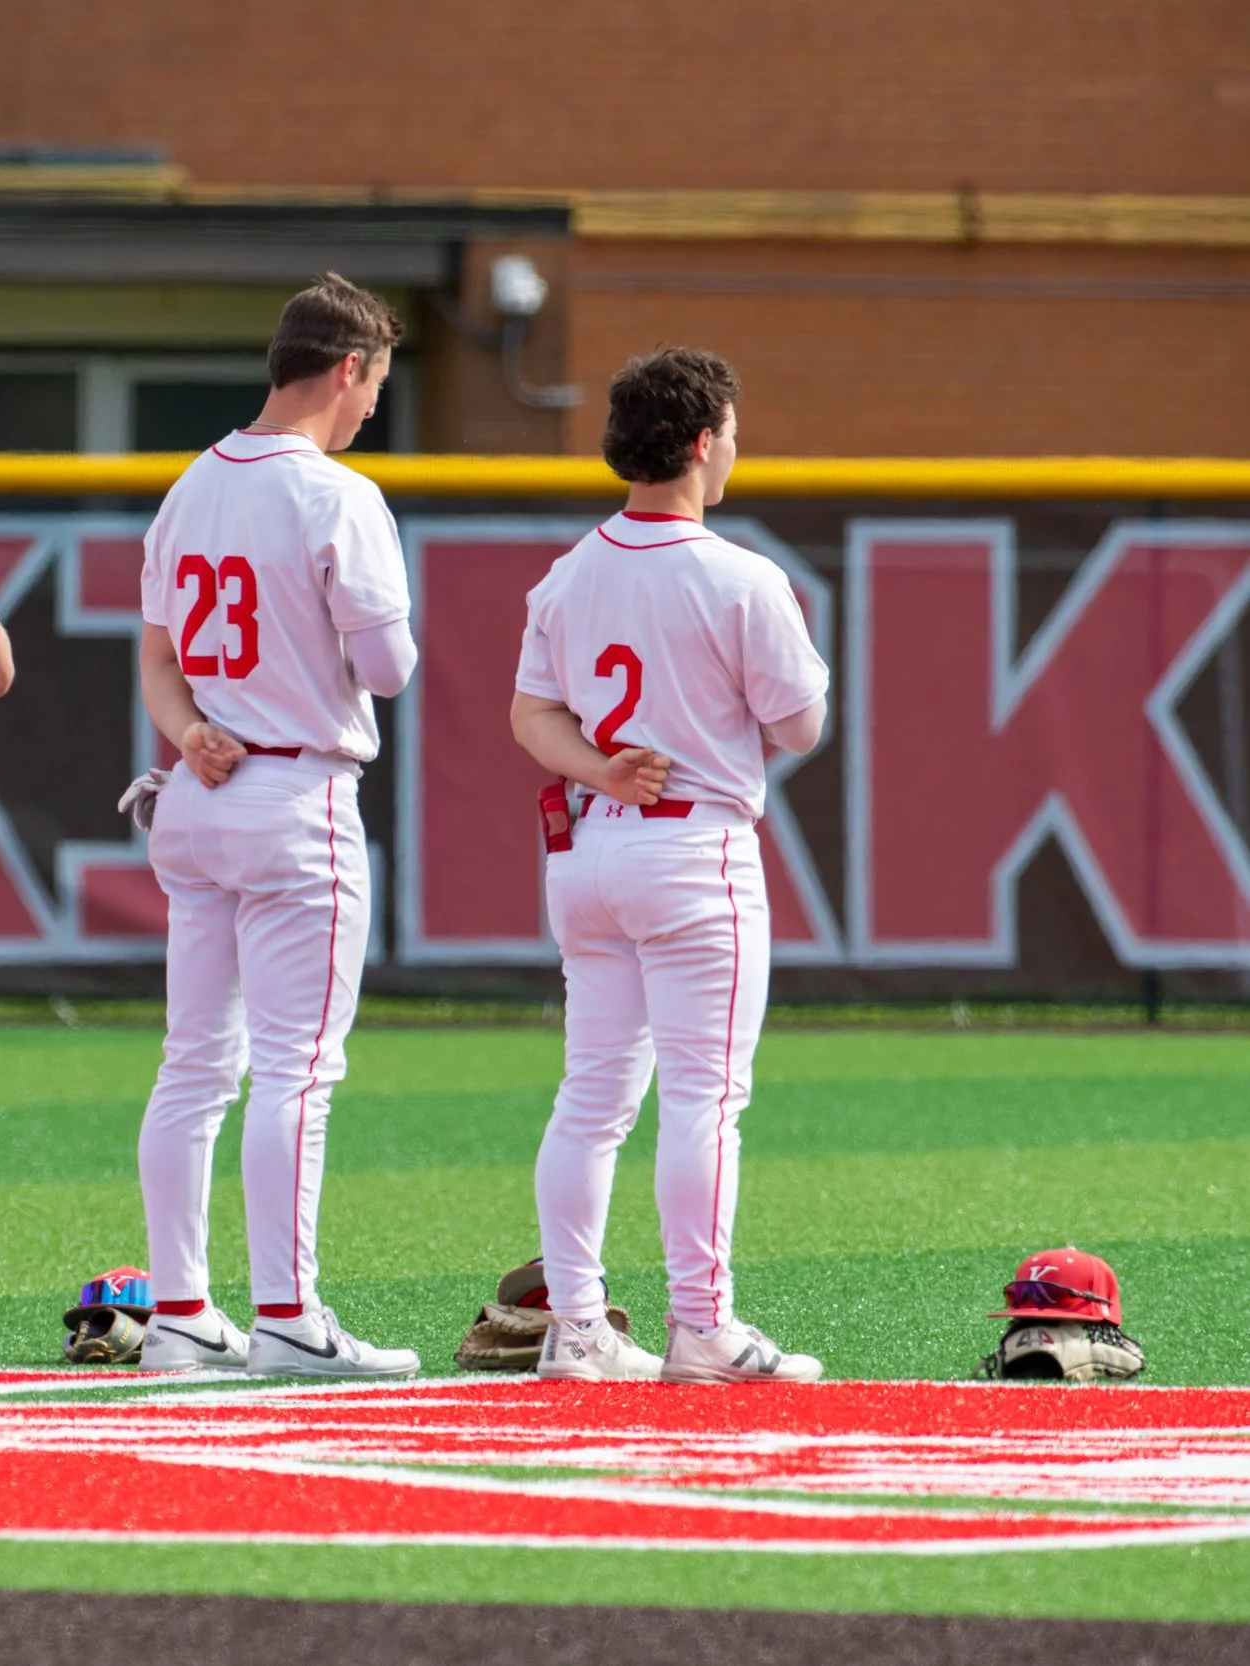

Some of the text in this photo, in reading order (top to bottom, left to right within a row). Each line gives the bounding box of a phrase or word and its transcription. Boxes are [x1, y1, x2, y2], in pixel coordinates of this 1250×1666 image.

[176, 554, 260, 679] 23
[594, 643, 646, 757] 2
[104, 1275, 134, 1296] K
